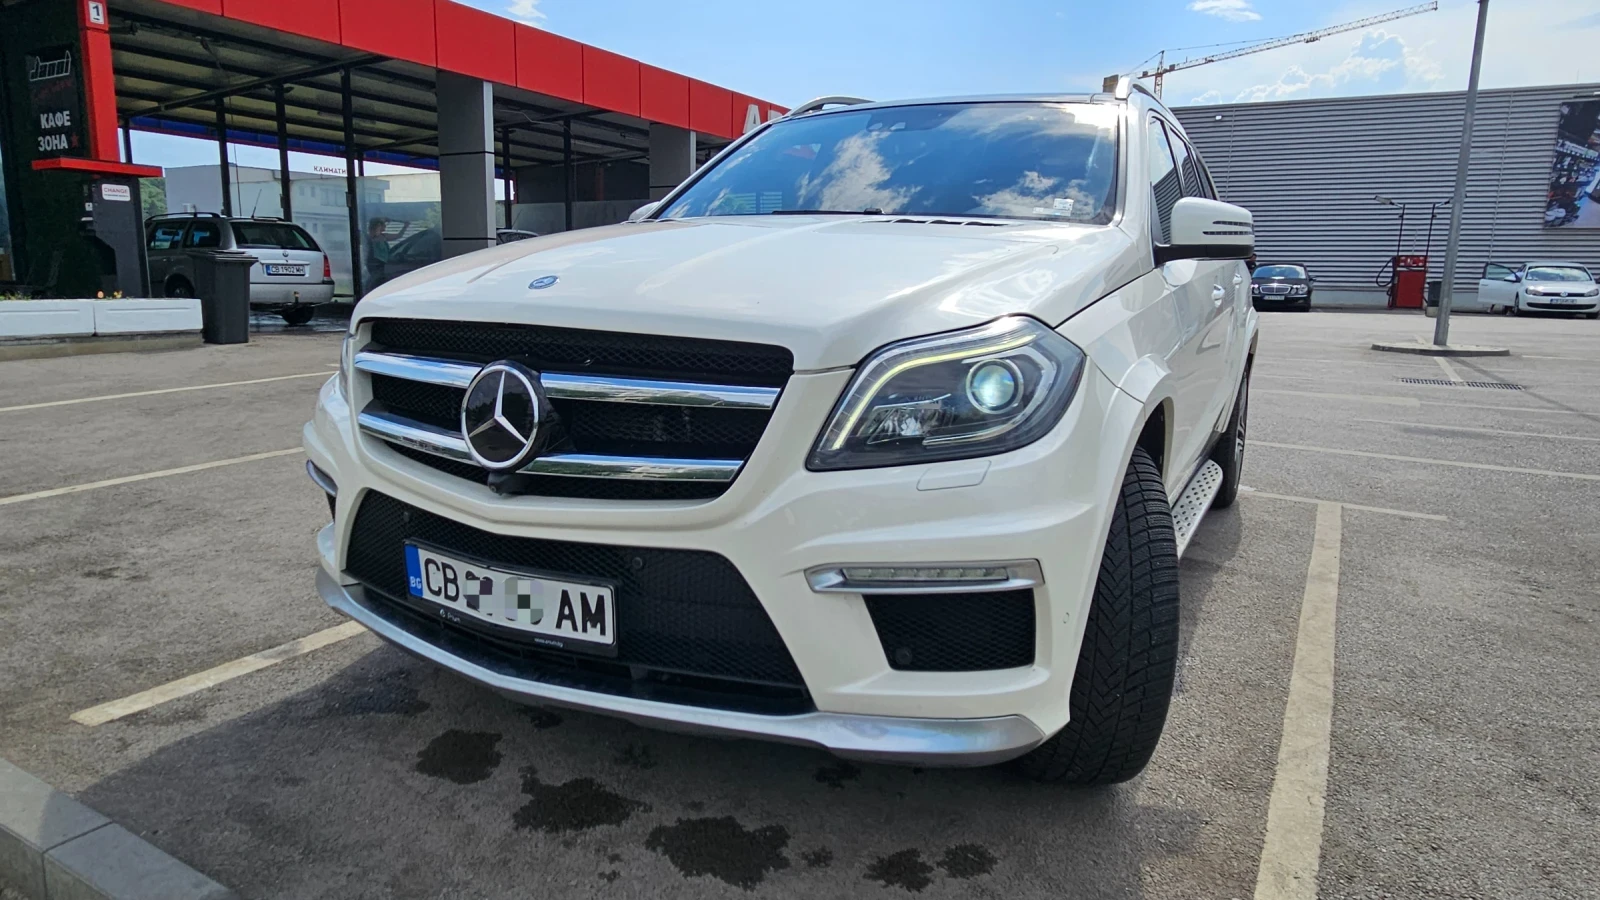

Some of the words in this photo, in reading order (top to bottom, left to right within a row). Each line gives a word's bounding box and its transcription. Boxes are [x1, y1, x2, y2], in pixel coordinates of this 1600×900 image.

[92, 4, 100, 16] 1
[40, 110, 71, 129] КАФЕ
[37, 134, 69, 151] ЗОНА
[409, 575, 422, 590] BG
[424, 557, 460, 603] CB
[555, 588, 607, 637] AM
